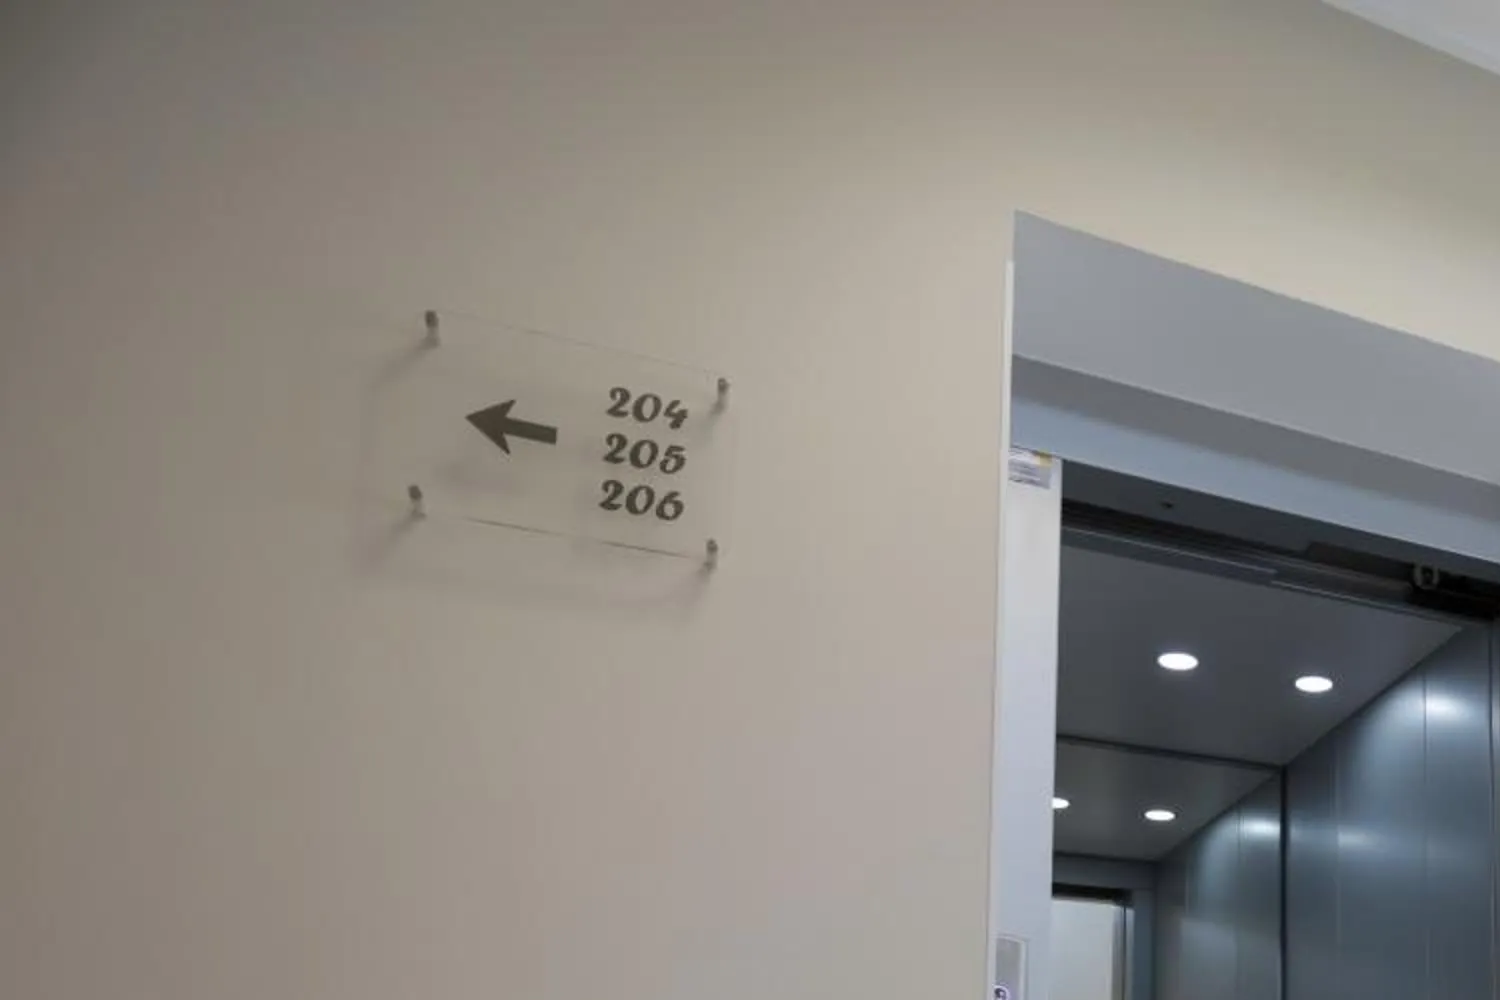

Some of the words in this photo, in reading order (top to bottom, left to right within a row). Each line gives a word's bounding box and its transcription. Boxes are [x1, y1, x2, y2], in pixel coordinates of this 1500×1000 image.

[605, 386, 688, 430] 204
[602, 433, 687, 475] 205
[598, 479, 685, 522] 206
